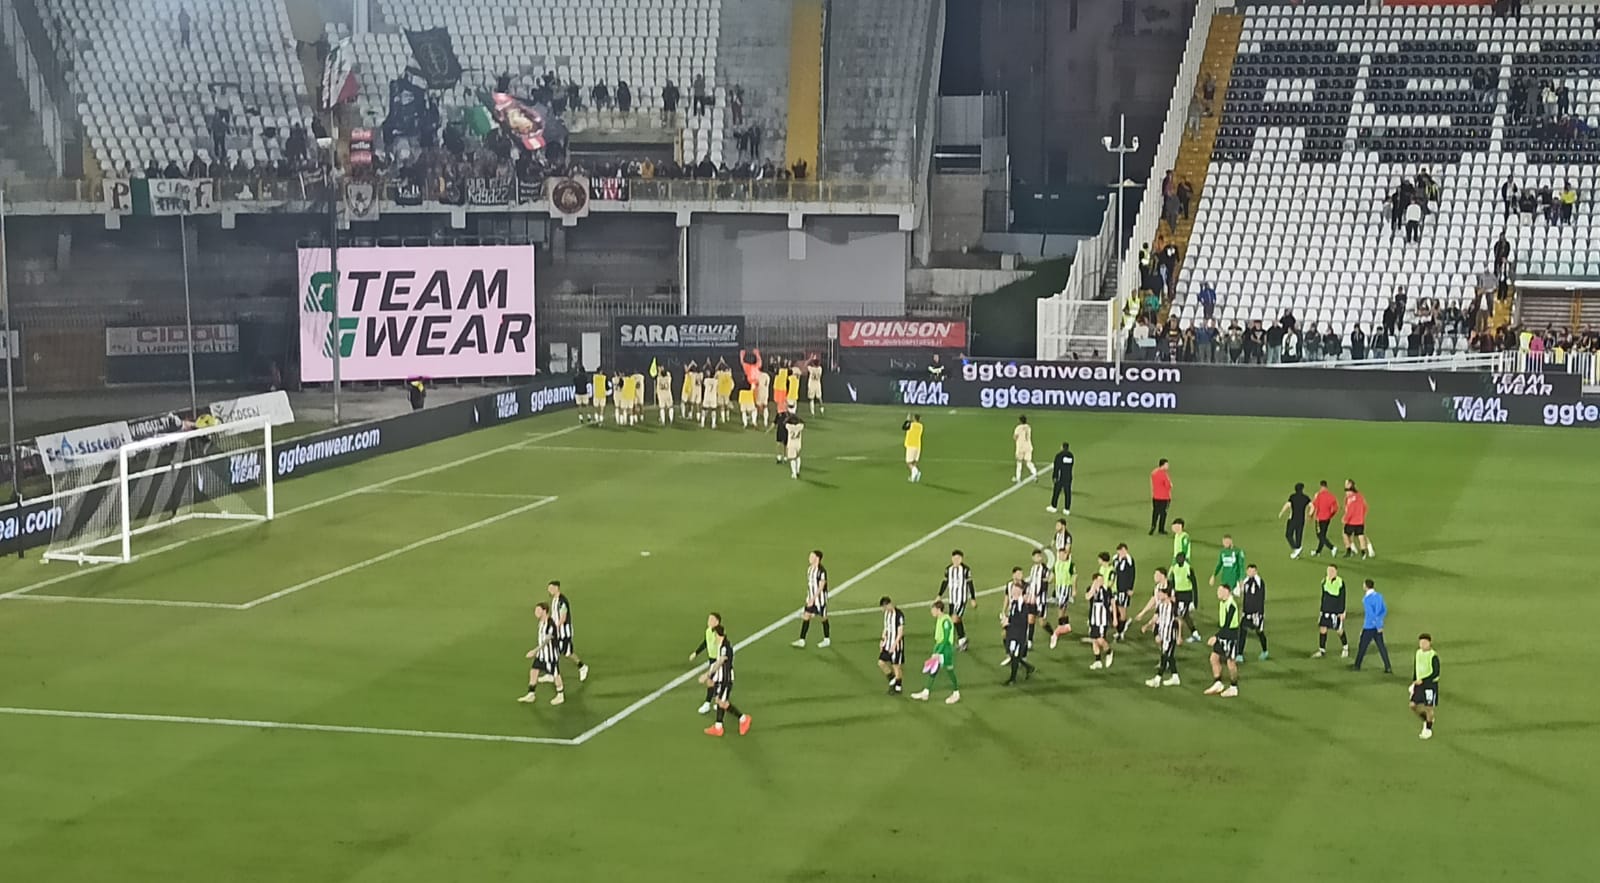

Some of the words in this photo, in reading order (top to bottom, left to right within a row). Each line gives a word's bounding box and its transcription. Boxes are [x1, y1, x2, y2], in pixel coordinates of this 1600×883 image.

[347, 269, 508, 312] TEAM
[365, 314, 532, 357] WEAR
[620, 324, 679, 343] SARA
[849, 321, 951, 340] JOHNSON
[962, 361, 1181, 383] ggteamwear.com
[1492, 373, 1545, 385] TEAM
[899, 380, 943, 393] TEAM
[1496, 384, 1553, 396] WEAR
[496, 393, 517, 407] TEAM
[904, 392, 949, 406] WEAR
[980, 384, 1177, 409] ggteamwear.com
[1453, 397, 1501, 410] TEAM
[498, 403, 519, 418] WEAR
[1457, 409, 1509, 422] WEAR
[1543, 401, 1600, 426] ggte
[277, 427, 380, 475] ggteamwear.com
[230, 453, 259, 469] TEAM
[231, 464, 261, 485] WEAR
